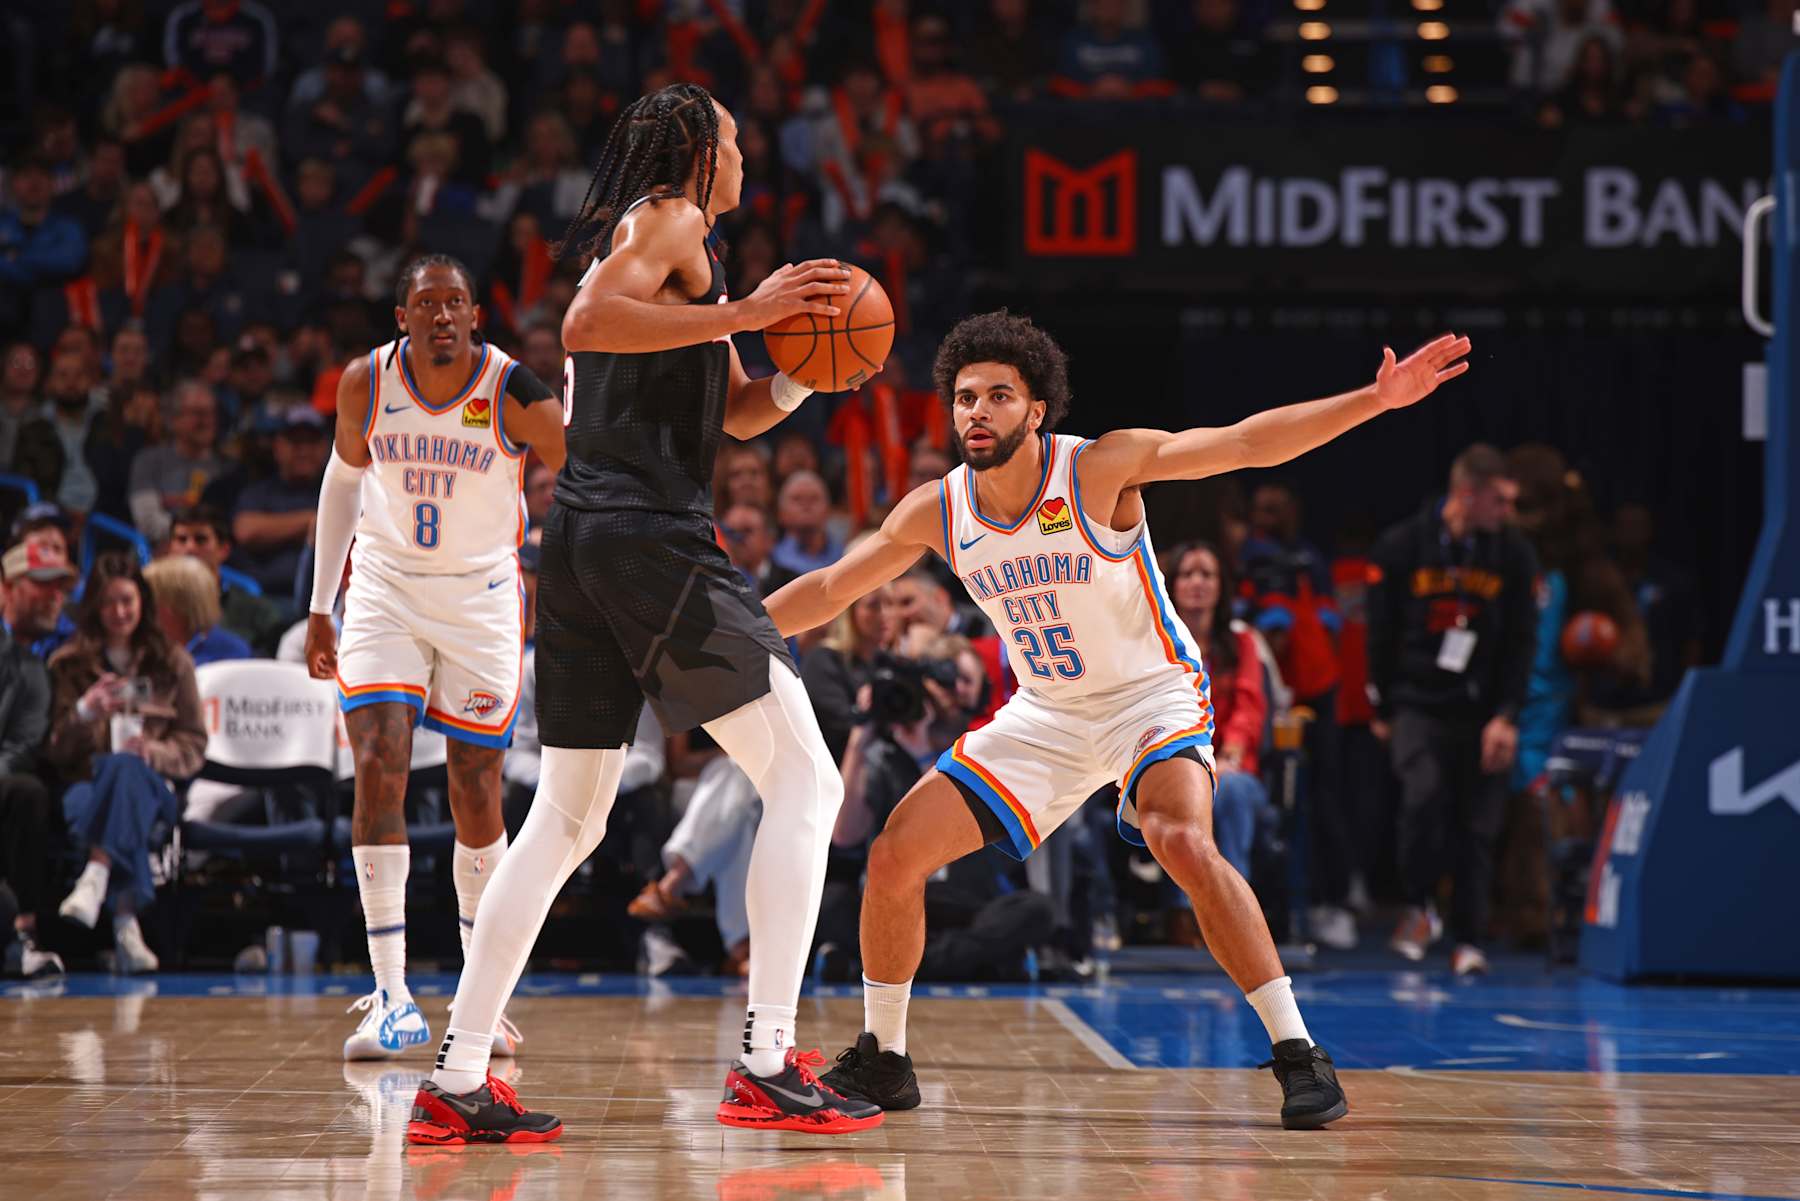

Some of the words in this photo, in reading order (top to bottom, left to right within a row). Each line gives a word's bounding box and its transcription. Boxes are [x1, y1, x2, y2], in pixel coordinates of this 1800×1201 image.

[1584, 167, 1765, 248] BAN
[373, 433, 496, 475] OKLAHOMA
[403, 467, 457, 499] CITY
[412, 500, 442, 551] 8
[961, 552, 1093, 602] OKLAHOMA
[1002, 590, 1061, 625] CITY
[1011, 622, 1086, 681] 25
